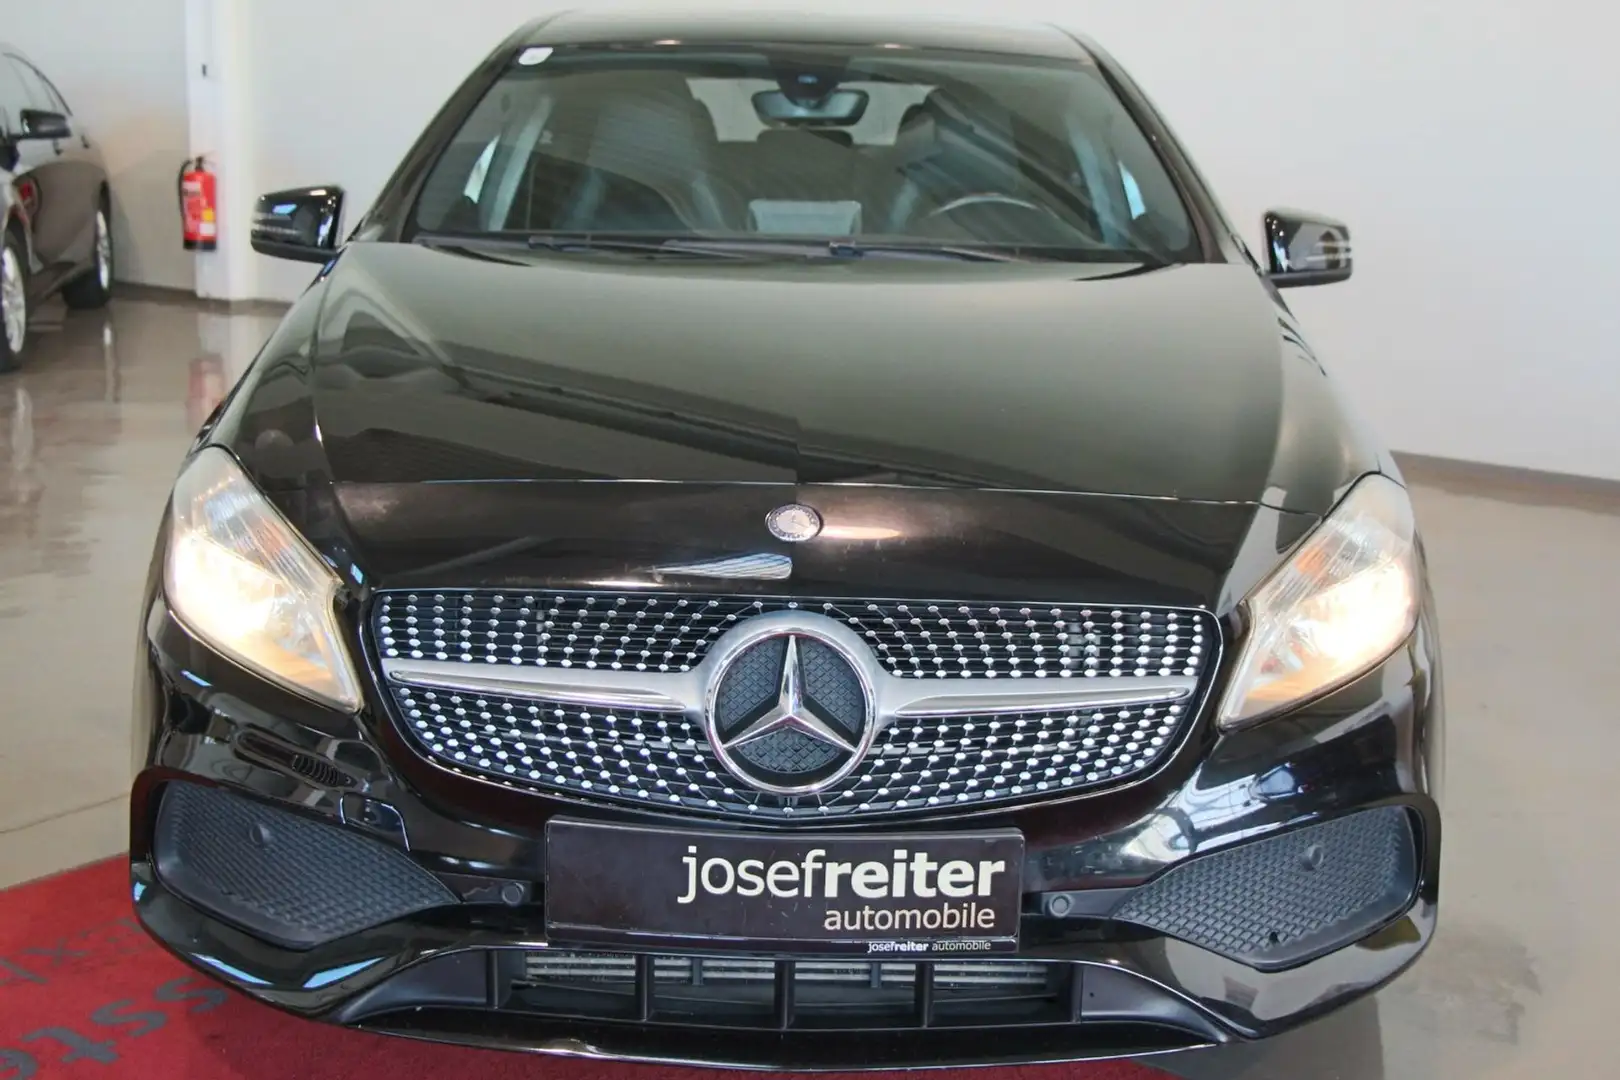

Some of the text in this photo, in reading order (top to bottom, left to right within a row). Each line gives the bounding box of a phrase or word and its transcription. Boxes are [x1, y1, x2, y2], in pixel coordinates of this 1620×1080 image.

[677, 845, 1005, 904] josefreiter
[824, 903, 995, 930] automobile
[867, 940, 991, 954] josefreiter automobile
